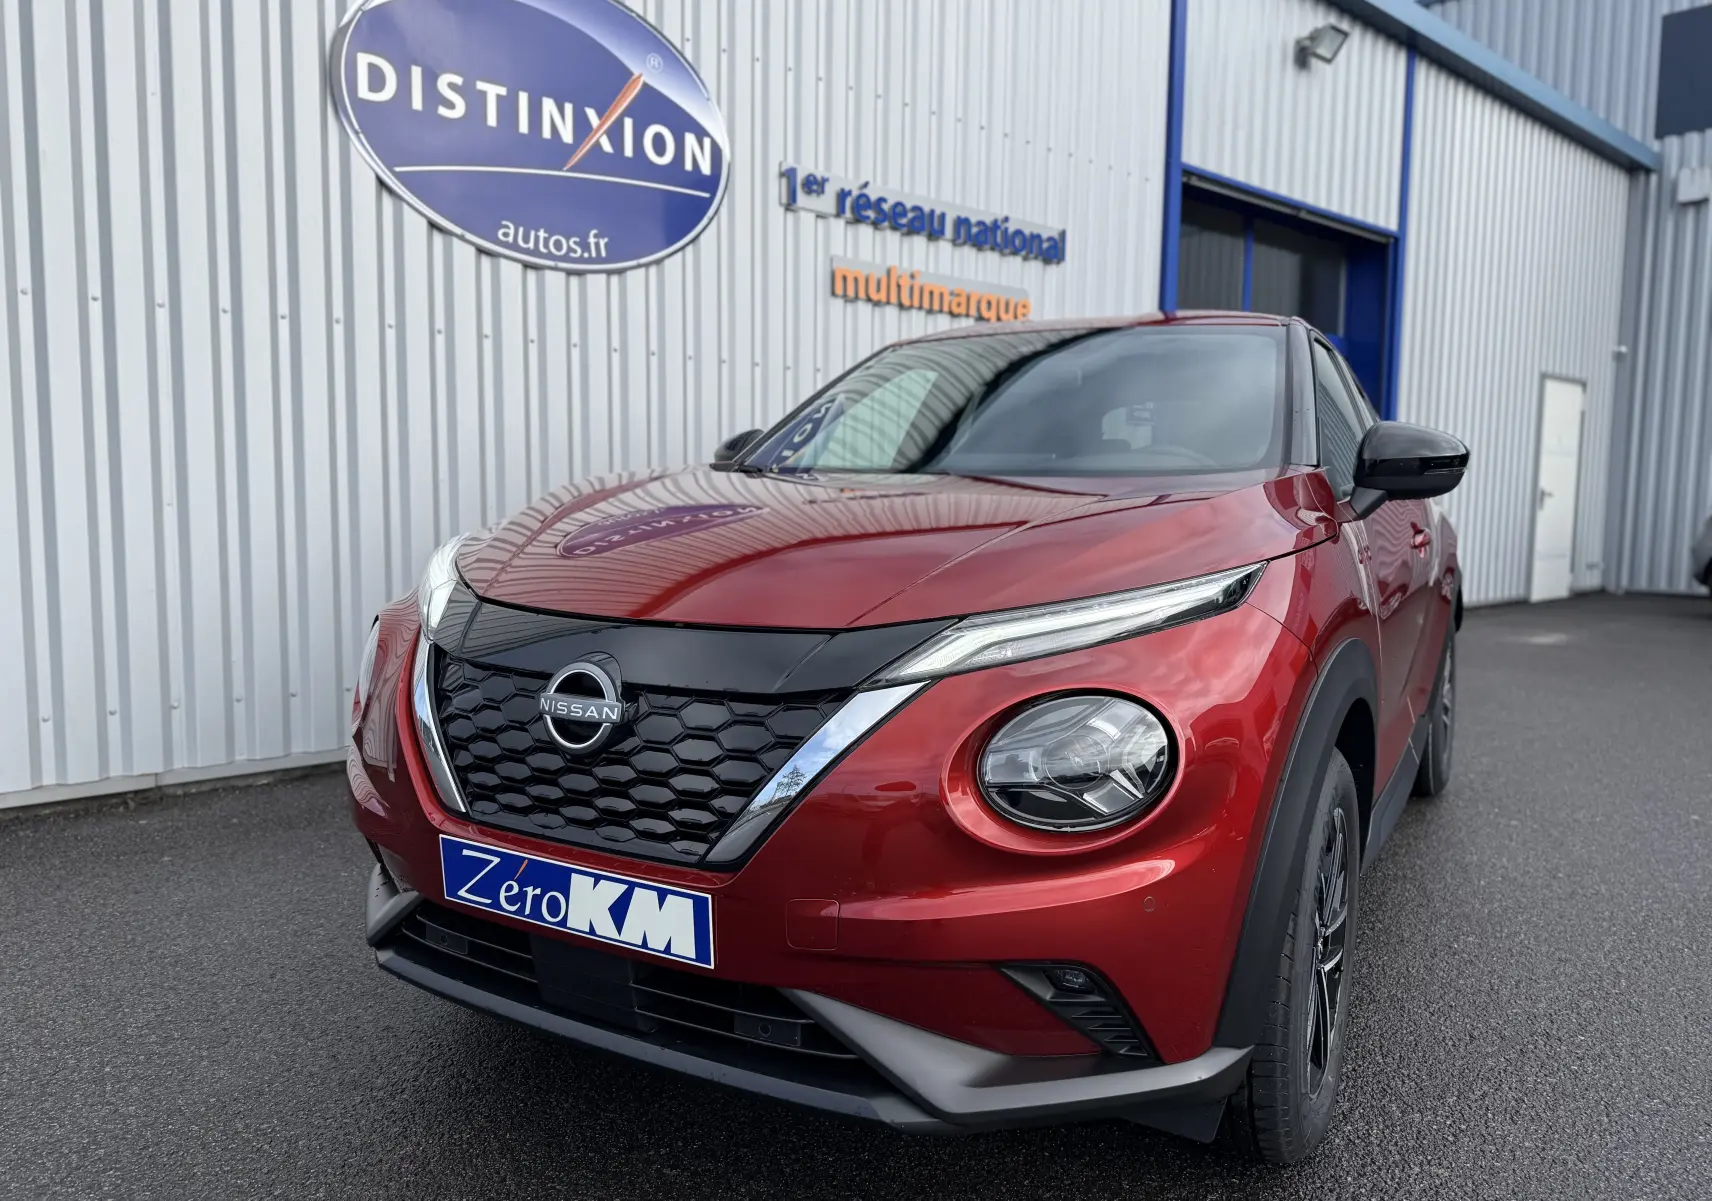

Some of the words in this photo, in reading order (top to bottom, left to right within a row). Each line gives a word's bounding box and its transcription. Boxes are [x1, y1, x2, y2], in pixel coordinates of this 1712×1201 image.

[356, 52, 712, 176] DISTINXION
[497, 220, 608, 258] autos.fr
[783, 166, 829, 205] 1er
[837, 181, 946, 237] réseau
[955, 215, 1067, 262] national
[832, 265, 1031, 322] multimarque
[540, 697, 618, 720] NISSAN
